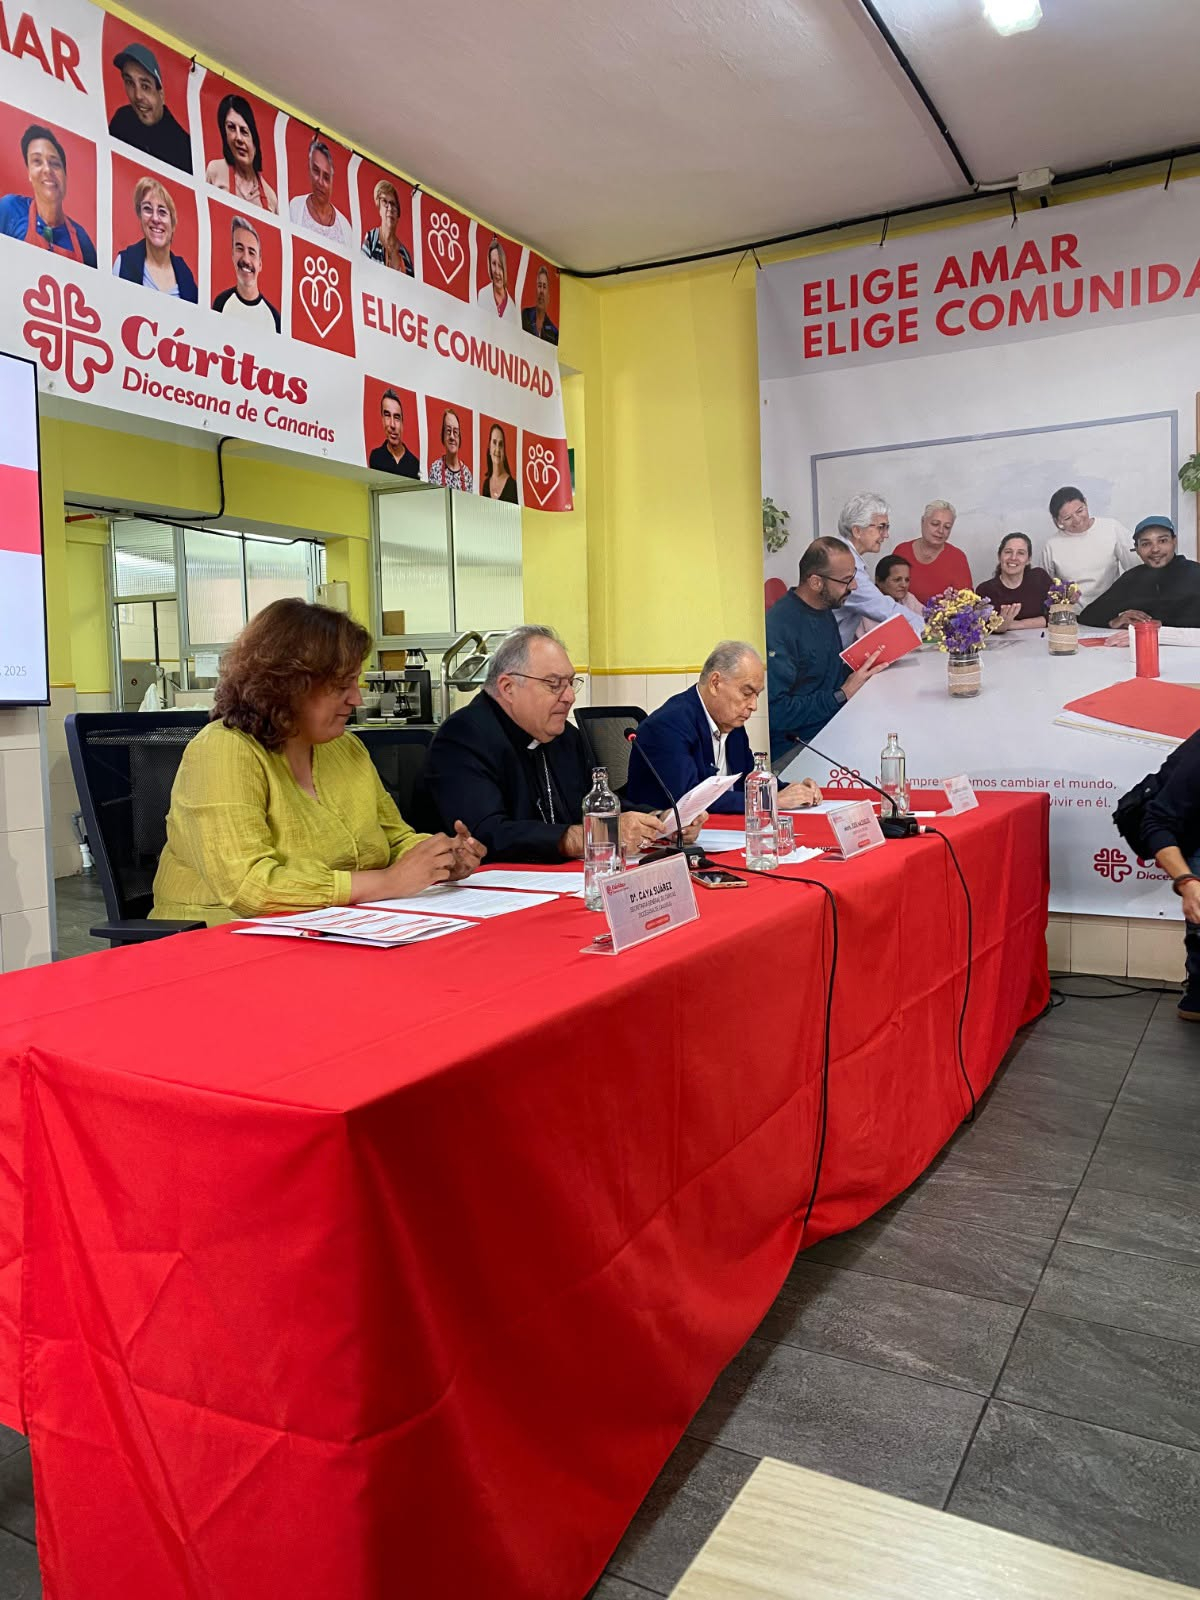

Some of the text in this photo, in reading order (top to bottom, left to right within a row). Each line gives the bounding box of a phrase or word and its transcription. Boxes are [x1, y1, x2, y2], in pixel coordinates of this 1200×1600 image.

[803, 233, 1081, 316] ELIGE AMAR
[361, 292, 554, 398] ELIGE COMUNIDAD
[804, 308, 918, 359] ELIGE
[121, 315, 308, 404] Cáritas
[122, 366, 335, 442] Diocesana de Canarias
[3, 665, 27, 677] 2025
[1001, 777, 1050, 788] cambiar
[1053, 778, 1065, 788] el
[1069, 778, 1117, 790] mundo.
[1077, 799, 1092, 807] en
[1096, 796, 1111, 808] él.
[639, 888, 653, 900] CAYA
[653, 881, 673, 895] SUÁREZ
[1137, 871, 1174, 880] Dioce
